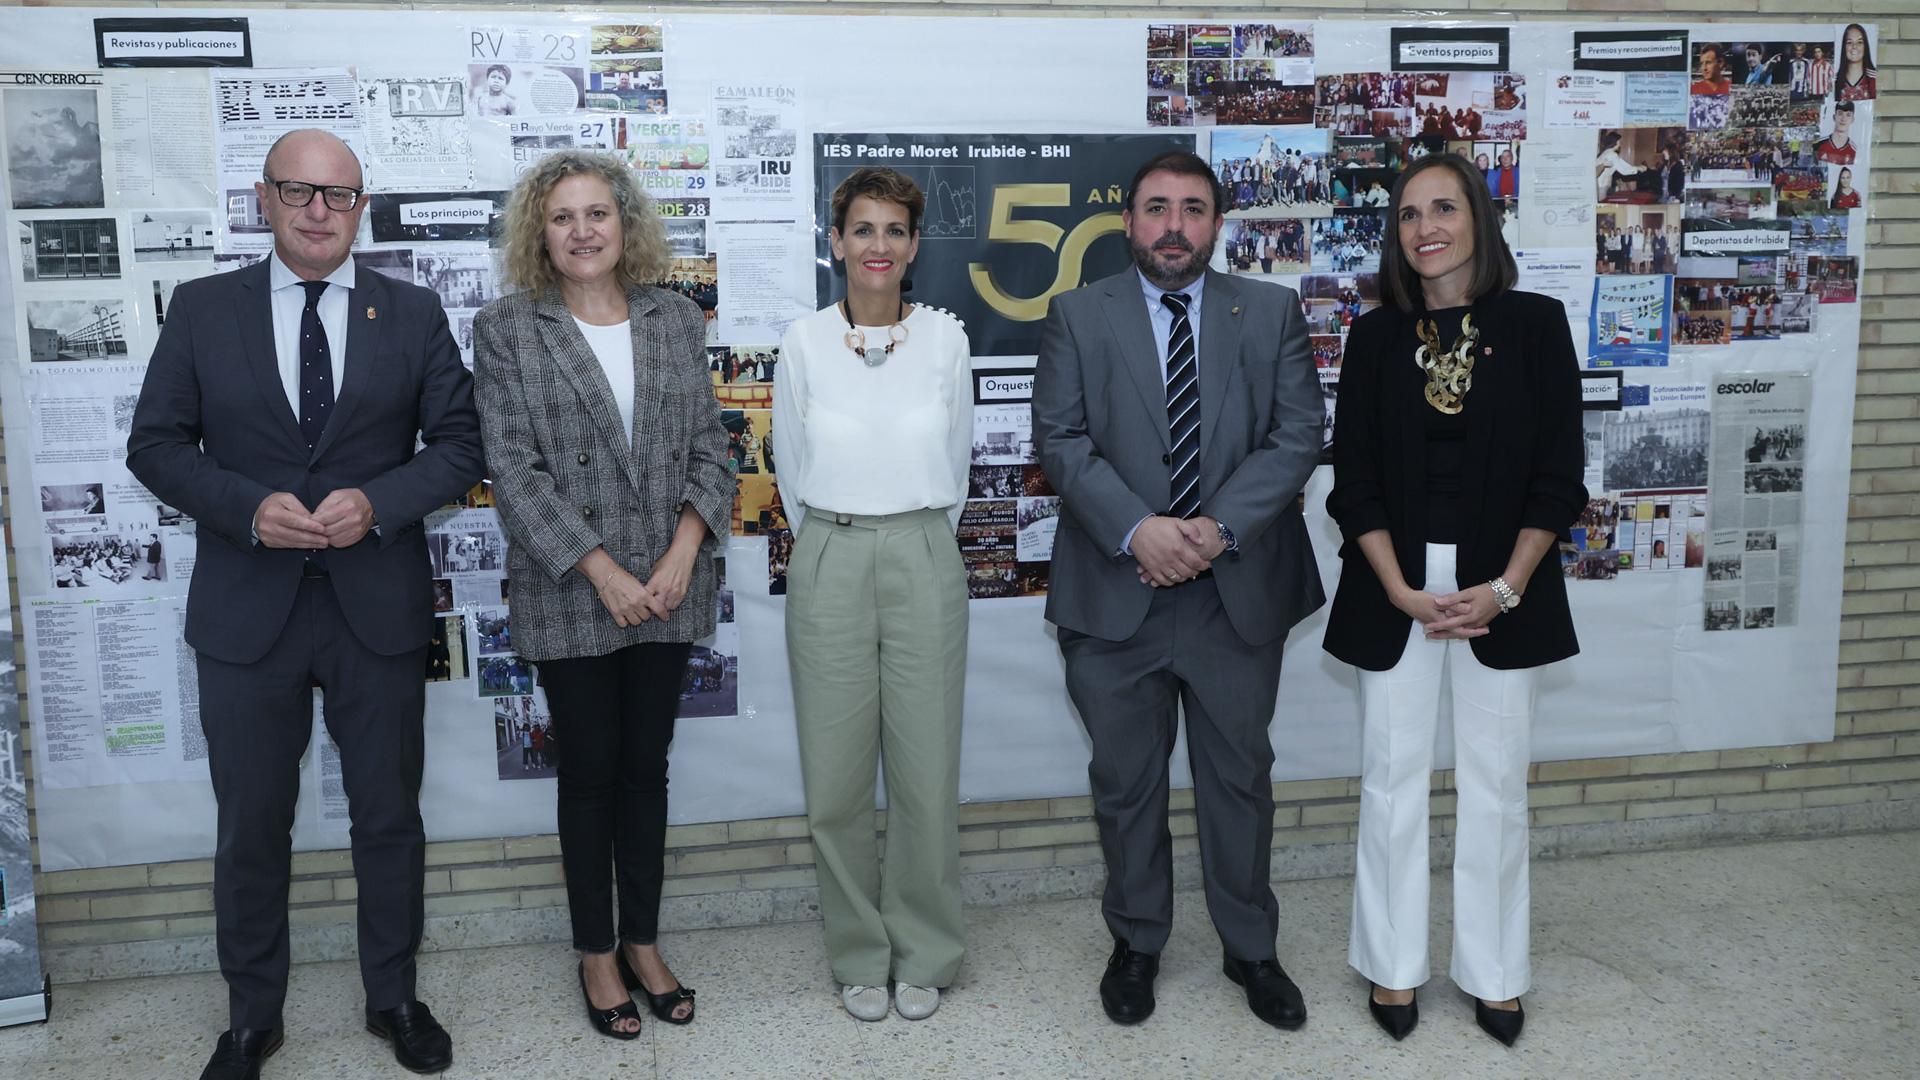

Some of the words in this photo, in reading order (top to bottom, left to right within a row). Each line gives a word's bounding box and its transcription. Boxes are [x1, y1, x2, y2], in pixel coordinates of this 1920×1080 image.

[111, 37, 156, 49] Revistas
[156, 41, 164, 50] y
[164, 38, 238, 50] publicaciones
[471, 31, 504, 58] RV
[543, 34, 576, 61] 23
[1587, 46, 1617, 54] Premios
[1623, 44, 1681, 54] reconocimientos
[1408, 45, 1452, 57] Eventos
[1453, 46, 1494, 58] propios
[15, 73, 87, 85] CENCERRO
[401, 83, 453, 111] RV
[716, 84, 796, 98] CAMALEÓN
[580, 123, 604, 138] 27
[823, 145, 852, 158] IES
[857, 144, 906, 158] Padre
[910, 145, 959, 158] Moret
[968, 144, 1027, 158] Irubide
[1041, 145, 1071, 158] BHI
[760, 160, 791, 175] IRU
[687, 176, 705, 189] 29
[760, 176, 791, 188] BIDE
[1086, 184, 1131, 204] AÑ
[409, 208, 429, 219] Los
[431, 208, 484, 220] principios
[687, 203, 706, 216] 28
[1692, 235, 1742, 246] Deportistas
[1743, 236, 1754, 245] de
[1754, 235, 1785, 245] Irubide
[109, 365, 147, 373] IRUBID
[985, 379, 1034, 393] Orquest
[1717, 378, 1776, 395] escolar
[450, 521, 494, 530] NUESTRA
